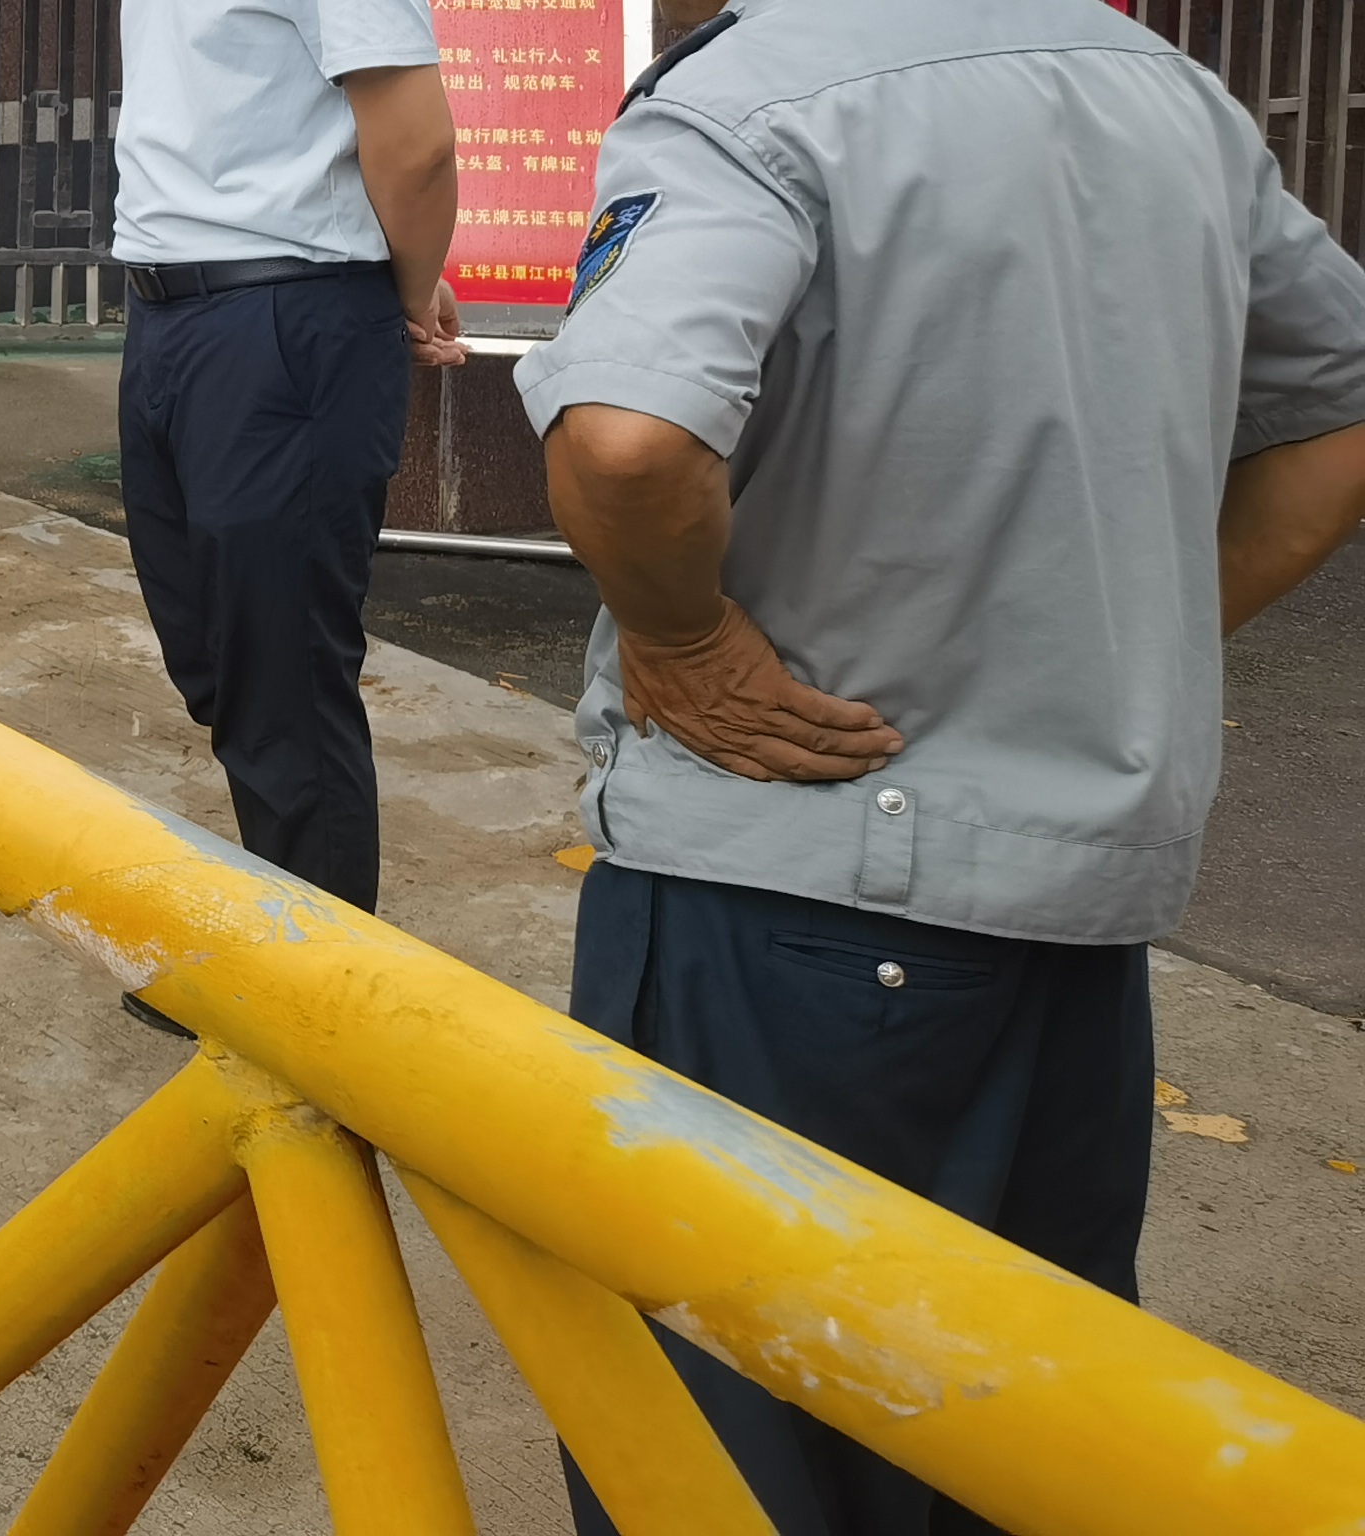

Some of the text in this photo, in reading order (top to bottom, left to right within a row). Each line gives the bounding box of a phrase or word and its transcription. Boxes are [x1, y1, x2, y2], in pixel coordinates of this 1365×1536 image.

[456, 208, 591, 227] 驶无牌无证车辆
